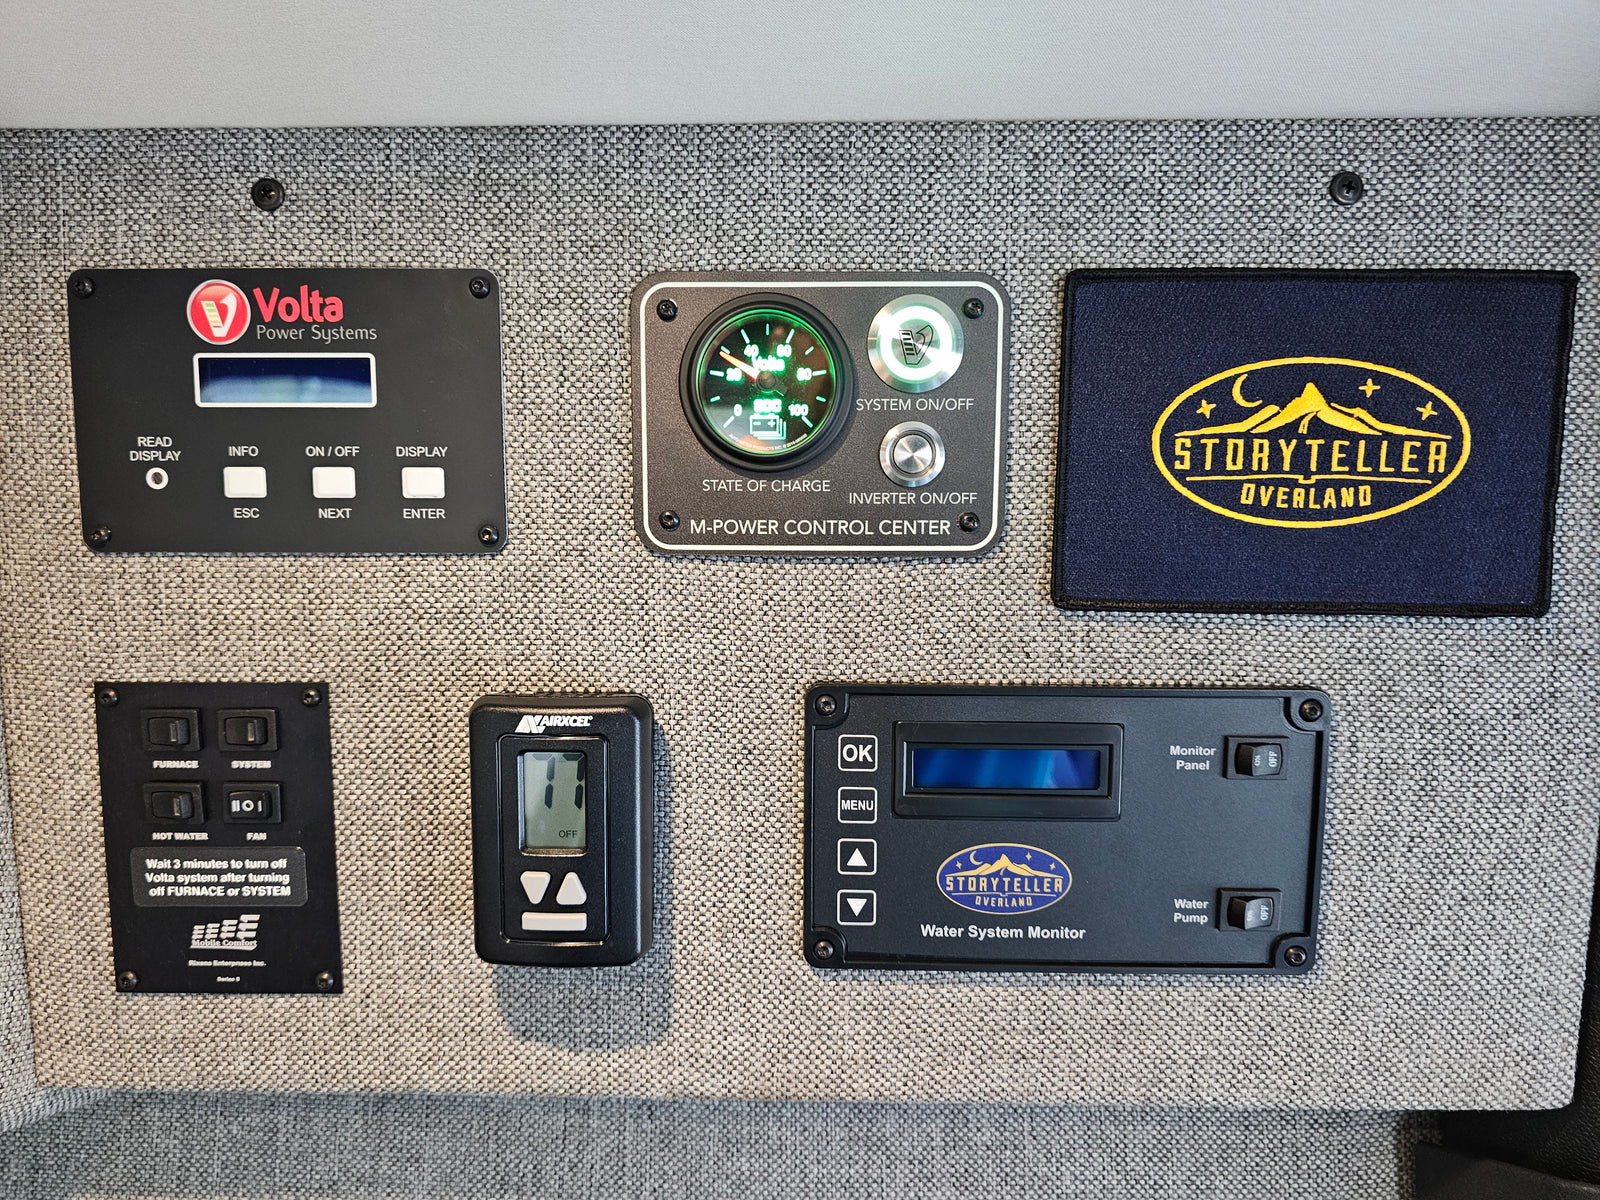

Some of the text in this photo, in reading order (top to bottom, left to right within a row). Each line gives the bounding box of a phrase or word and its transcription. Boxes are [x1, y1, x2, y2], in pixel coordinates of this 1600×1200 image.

[253, 285, 344, 323] Volta
[256, 325, 377, 345] Power Systems
[734, 404, 742, 416] 0
[788, 404, 809, 416] 100
[855, 399, 974, 411] SYSTEM ON/OFF
[137, 436, 173, 448] READ
[129, 450, 182, 462] DISPLAY
[228, 446, 259, 457] INFO
[305, 446, 326, 457] ON
[334, 446, 360, 457] OFF
[395, 446, 448, 458] DISPLAY
[1173, 438, 1450, 474] STORYTELLER
[702, 479, 831, 492] STATE OF CHARGE
[849, 492, 978, 505] INVERTER ON/OFF
[1240, 484, 1372, 510] OVERLAND
[233, 508, 260, 519] ESC
[318, 508, 352, 519] NEXT
[402, 508, 446, 520] ENTER
[690, 519, 951, 536] M-POWER CONTROL CENTER
[842, 744, 874, 763] OK
[1169, 745, 1216, 756] Monitor
[153, 760, 200, 769] FURNACE
[231, 760, 272, 769] SYSTEM
[1176, 760, 1210, 771] Panel
[1268, 751, 1278, 768] OFF
[841, 800, 875, 811] MENU
[152, 832, 209, 841] HOT WATER
[246, 832, 267, 841] FAN
[558, 830, 578, 839] OFF
[145, 858, 288, 869] Wait 3 minutes to turn off
[145, 872, 290, 885] Volta system after turning
[945, 876, 1063, 893] STORYTELLER
[148, 886, 292, 897] off FURNACE or SYSTEM
[975, 896, 1033, 908] OVERLAND
[1173, 899, 1209, 909] Water
[1259, 904, 1270, 921] OFF
[1173, 912, 1209, 926] Pump
[920, 924, 1087, 941] Water System Monitor
